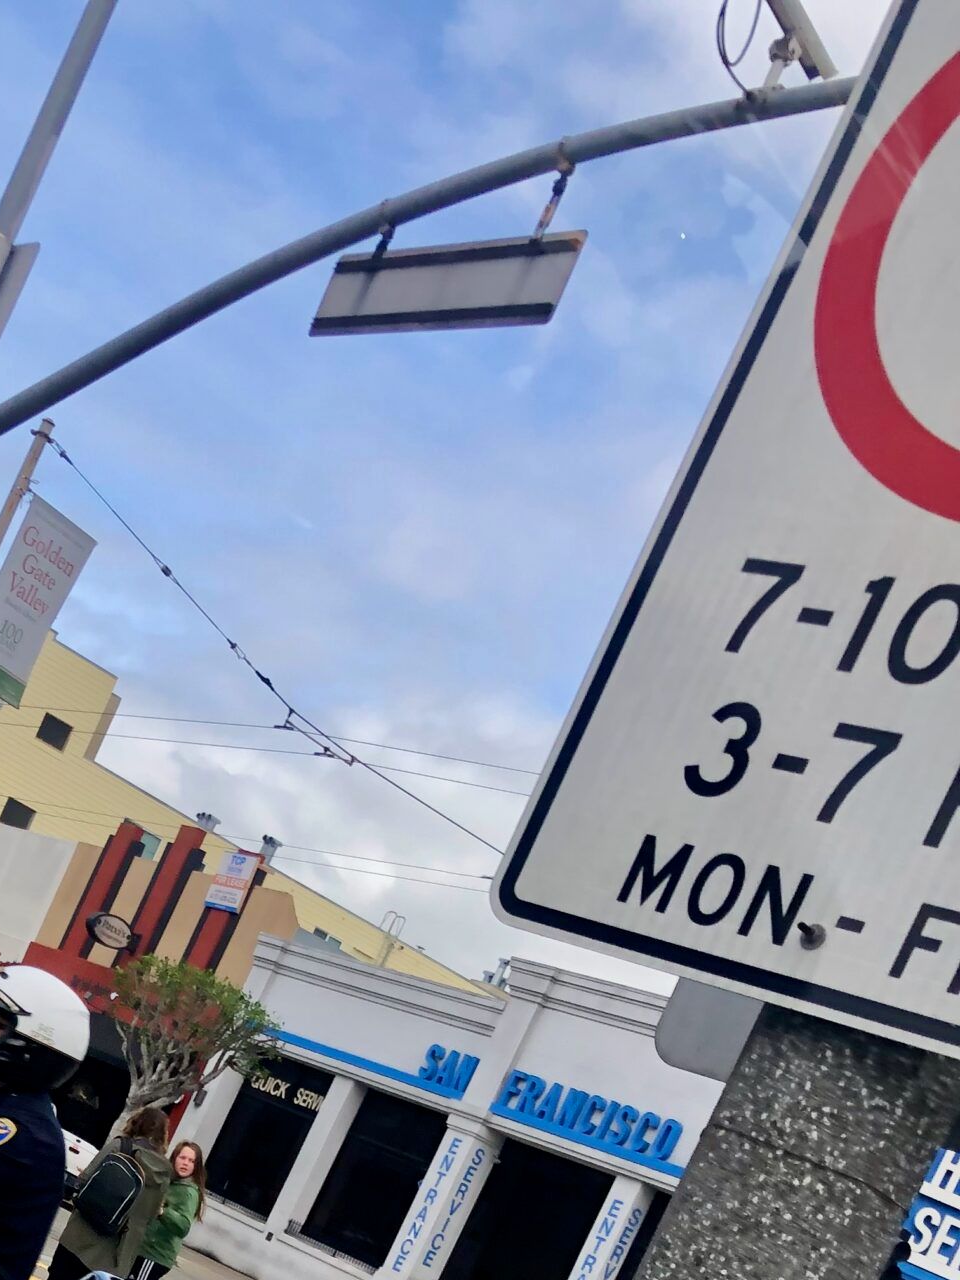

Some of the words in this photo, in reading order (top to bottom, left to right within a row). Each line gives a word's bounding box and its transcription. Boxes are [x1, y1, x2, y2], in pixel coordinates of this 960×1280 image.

[22, 525, 75, 578] Golden
[22, 553, 56, 591] Gate
[9, 571, 50, 615] Valley
[684, 702, 903, 824] 3-7
[888, 902, 960, 995] F
[250, 1076, 291, 1099] QUICK
[418, 1044, 480, 1094] SAN
[501, 1069, 683, 1163] FRANCISCO
[392, 1137, 462, 1272] ENTRANCE
[422, 1148, 485, 1267] SERVICE
[907, 1206, 960, 1272] SE
